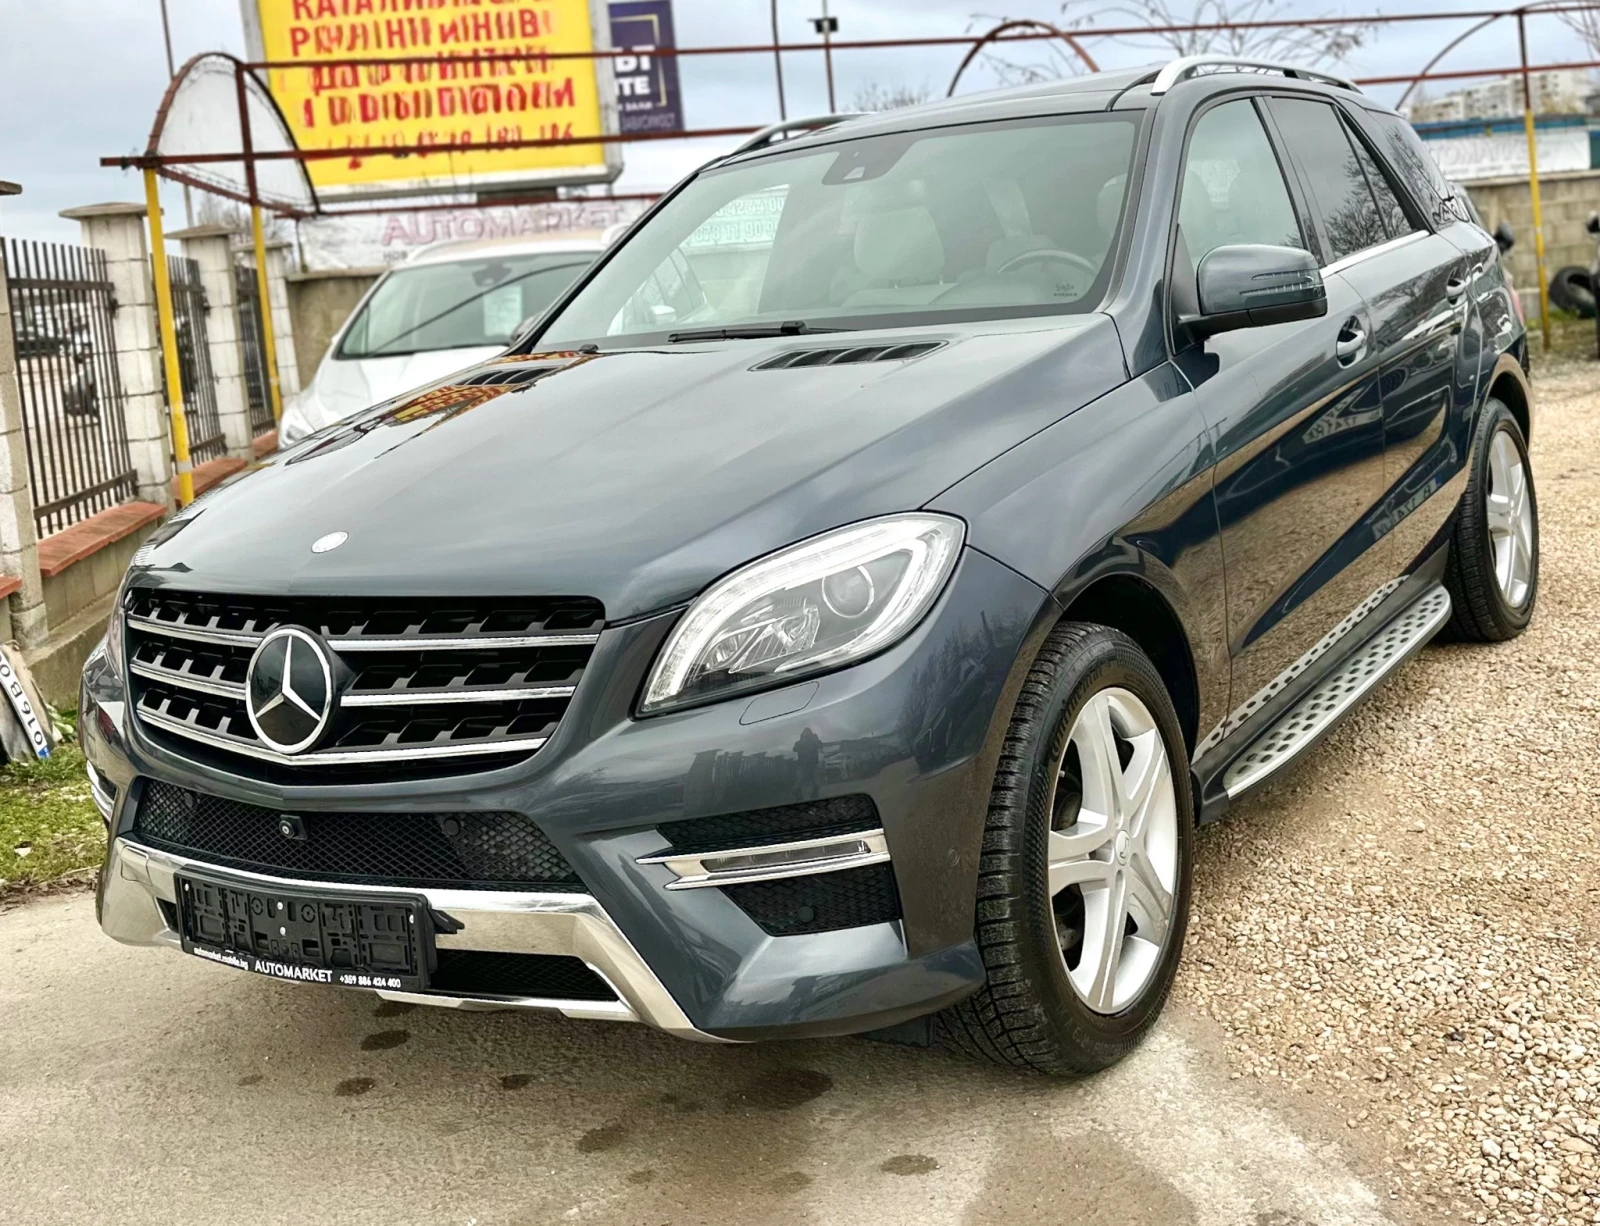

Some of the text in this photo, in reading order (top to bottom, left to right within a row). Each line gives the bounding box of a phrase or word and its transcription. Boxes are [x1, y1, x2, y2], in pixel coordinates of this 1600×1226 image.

[382, 204, 624, 246] AUTOMARKET
[254, 960, 333, 983] AUTOMARKET
[339, 974, 357, 985] +359
[373, 976, 387, 987] 424
[387, 977, 402, 988] 400
